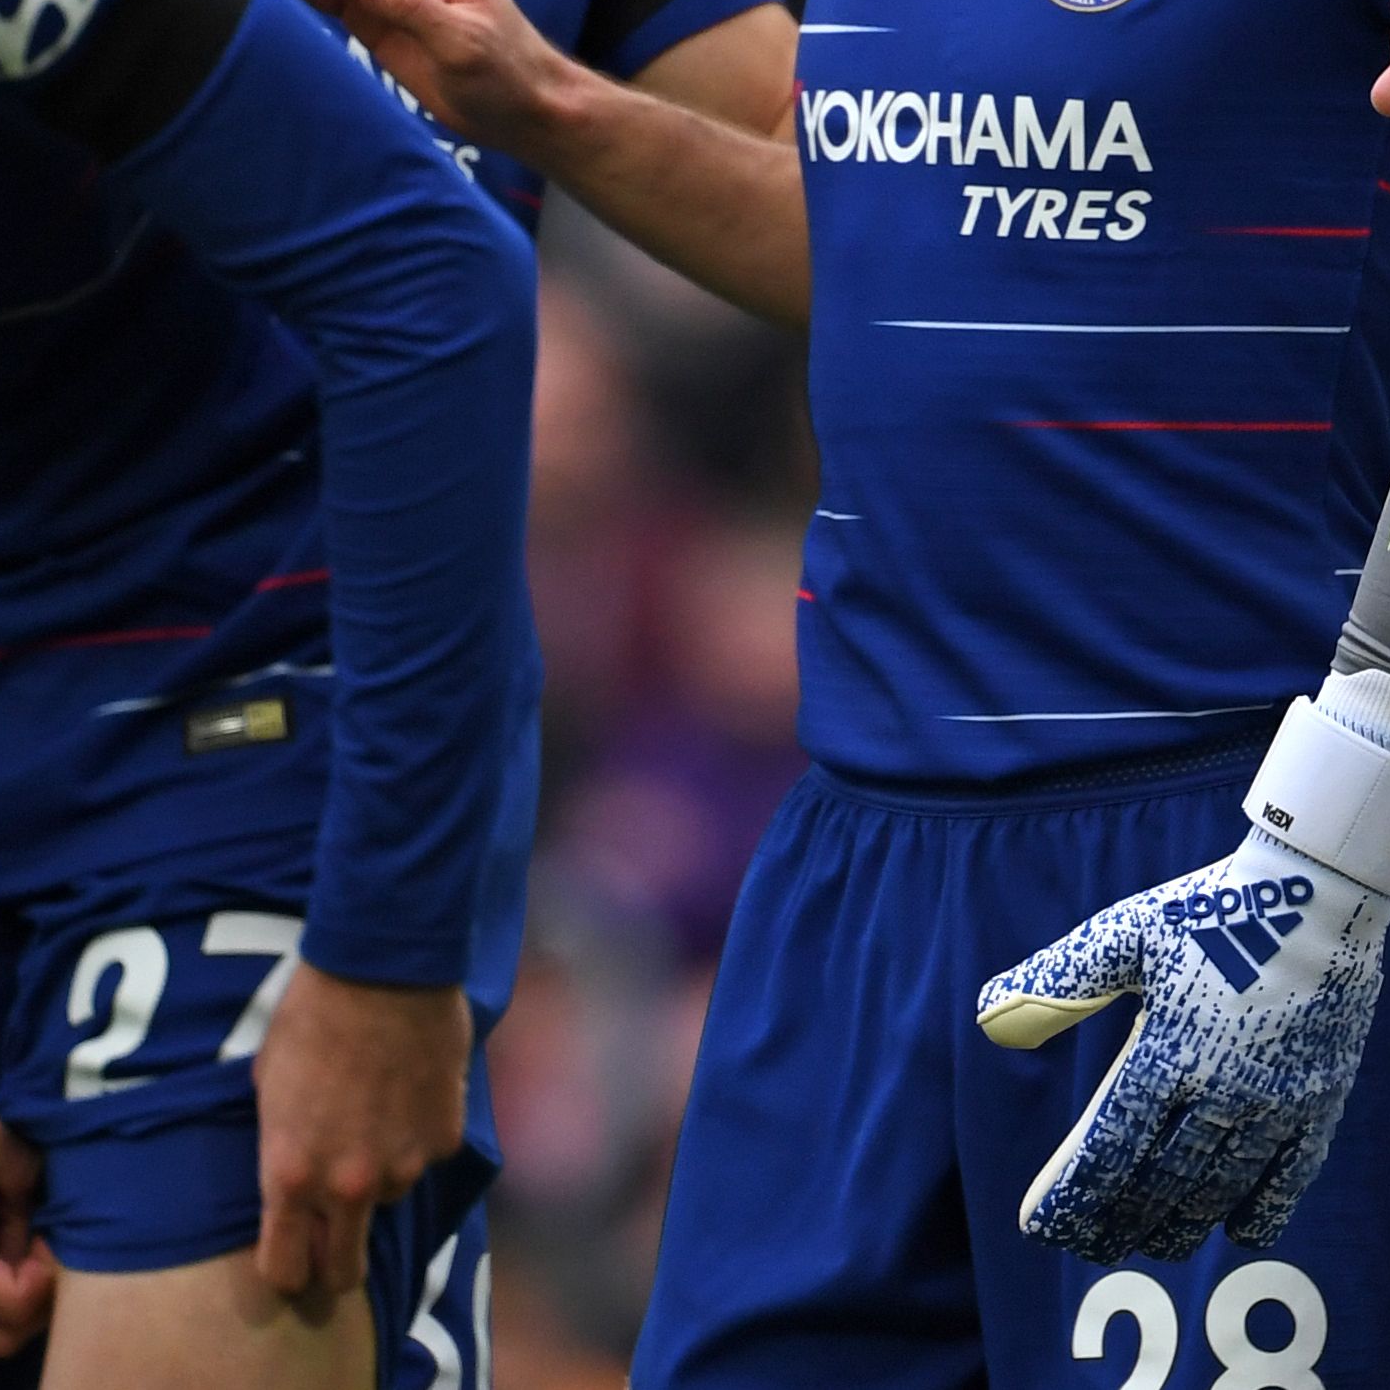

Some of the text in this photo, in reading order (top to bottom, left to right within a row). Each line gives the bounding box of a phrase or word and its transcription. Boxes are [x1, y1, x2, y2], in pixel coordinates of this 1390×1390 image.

[800, 88, 1153, 173] YOKOHAMA
[960, 185, 1152, 242] TYRES
[1261, 800, 1295, 833] KEPA
[1162, 875, 1315, 927] adidas
[64, 911, 307, 1101] 27
[1071, 1259, 1329, 1390] 28
